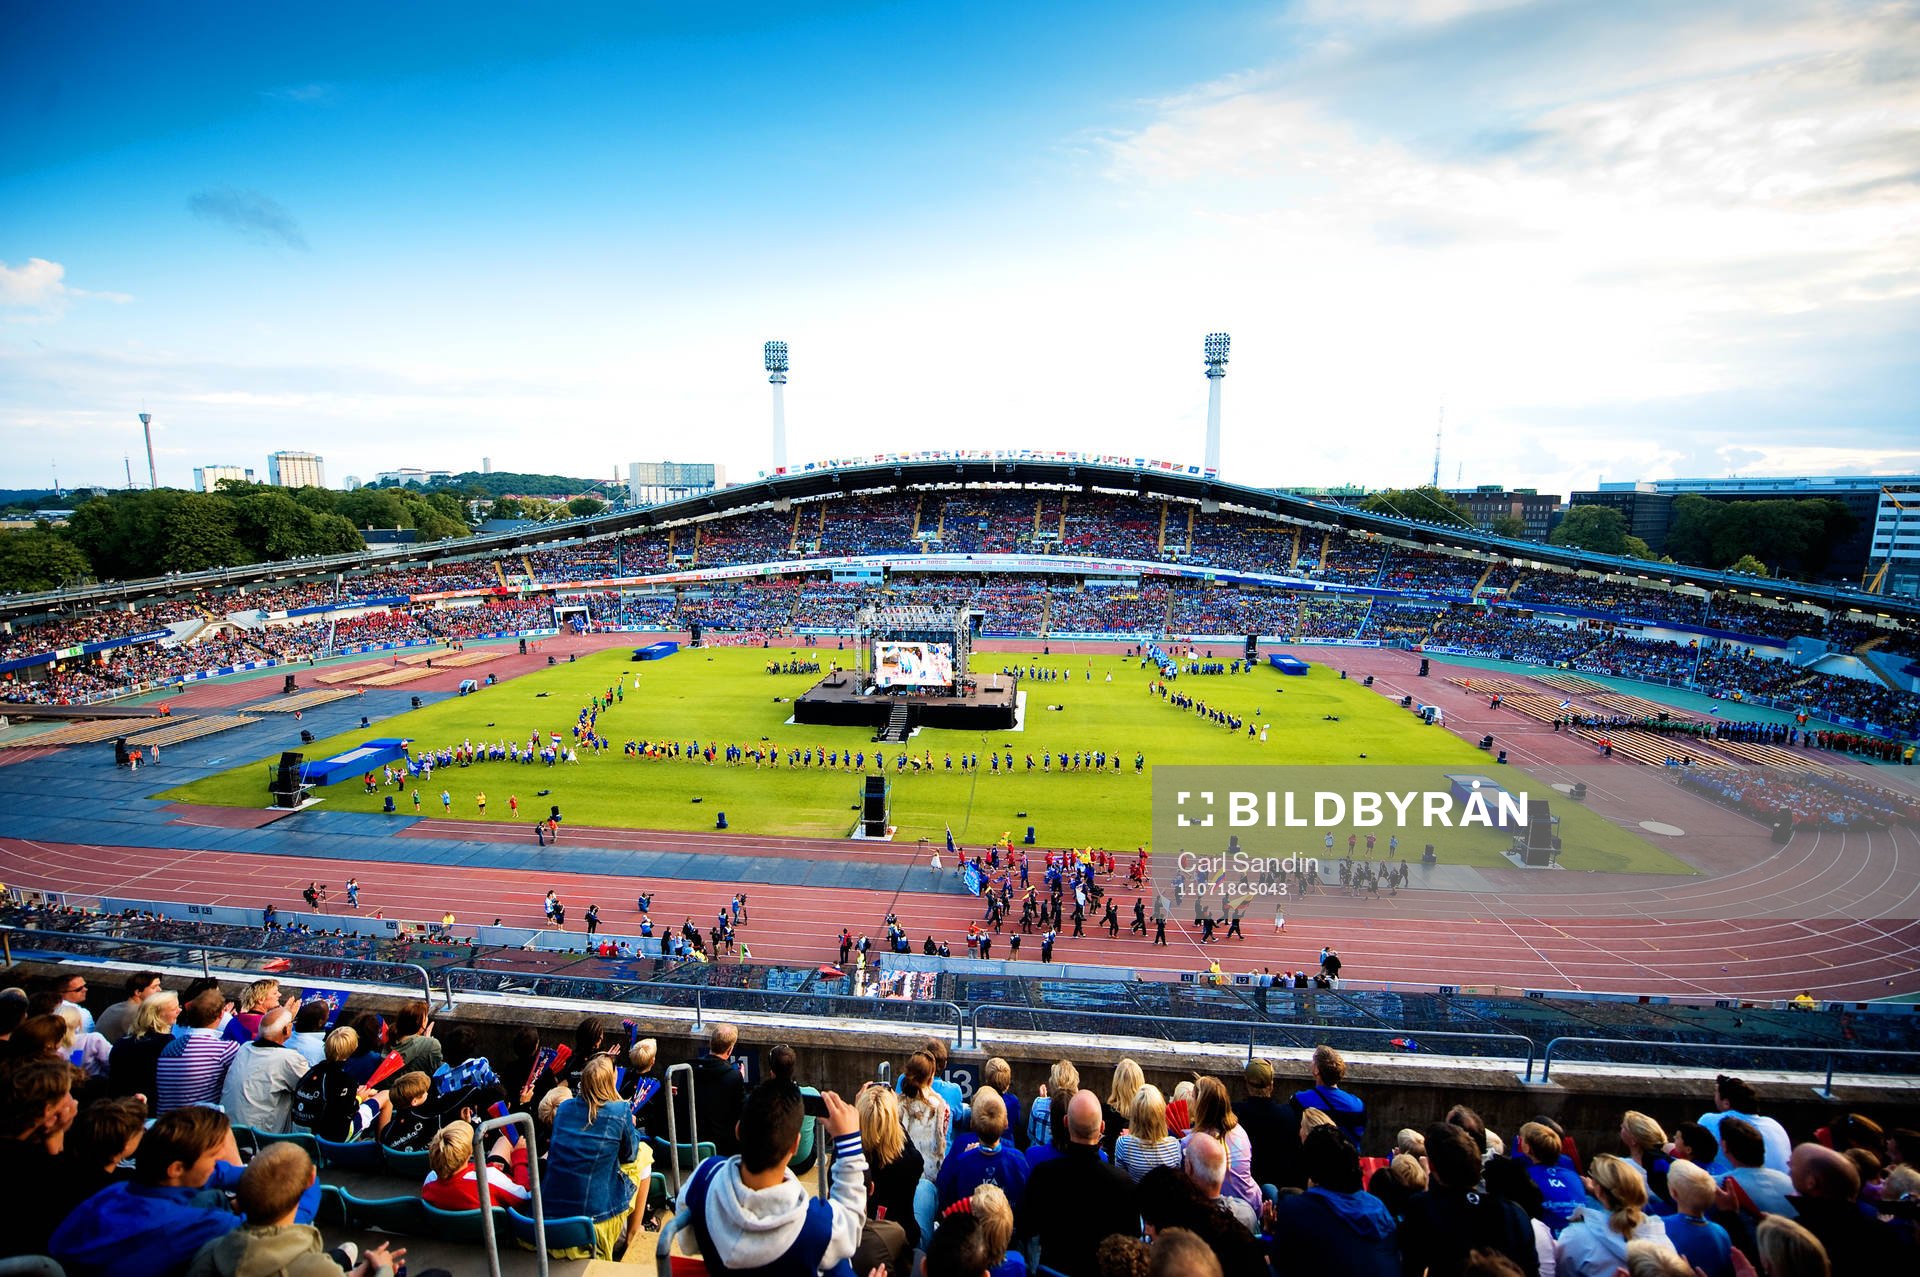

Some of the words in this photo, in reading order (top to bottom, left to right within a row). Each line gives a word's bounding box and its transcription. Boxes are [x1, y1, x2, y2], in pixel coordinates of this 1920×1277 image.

[1468, 650, 1500, 659] COMVIQ
[1513, 655, 1547, 665] COMVIQ
[1575, 664, 1612, 675] COMVIQ
[1548, 1178, 1566, 1188] ICA
